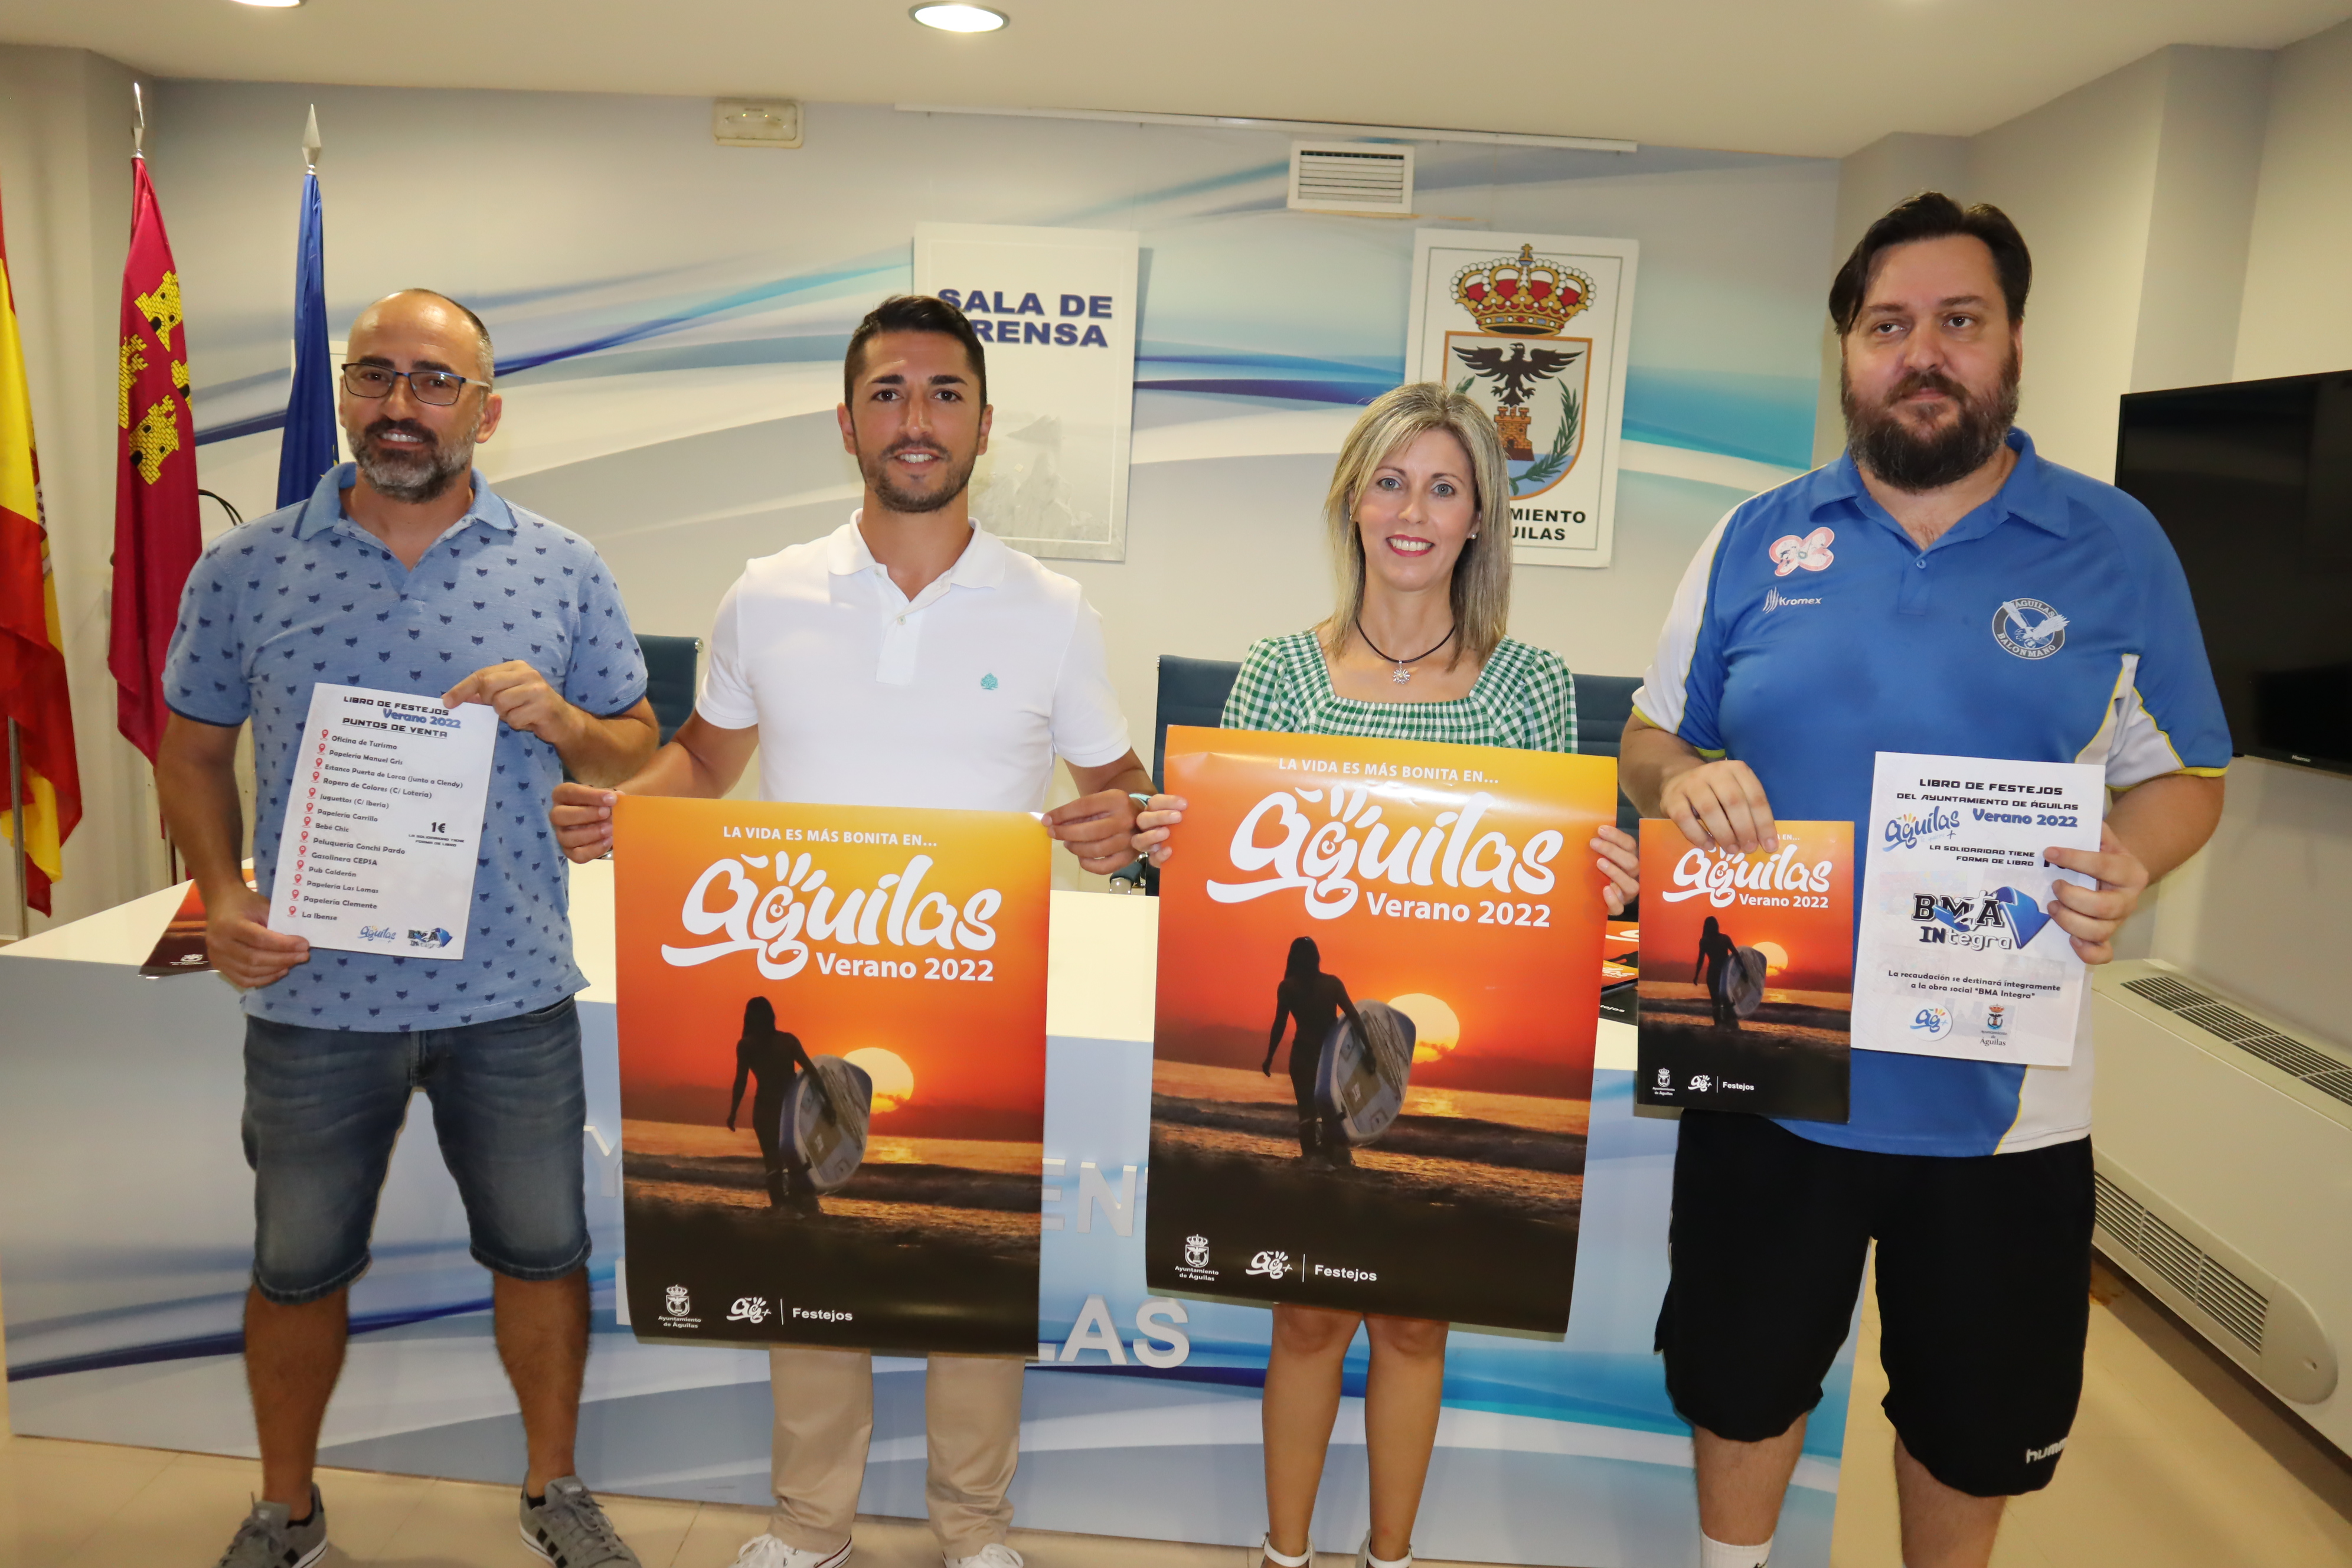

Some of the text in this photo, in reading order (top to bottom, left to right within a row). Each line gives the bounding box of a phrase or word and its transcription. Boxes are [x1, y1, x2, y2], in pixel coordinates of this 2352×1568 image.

[937, 288, 1113, 319] SALA DE
[969, 319, 1109, 348] RENSA
[1779, 596, 1822, 606] Kromex
[1997, 632, 2056, 657] BALONMANO
[344, 696, 374, 705] LIBRO
[394, 703, 449, 716] FESTEJOS
[383, 708, 461, 729] Verano 2022
[342, 717, 447, 737] PUNTOS DE VENTA
[332, 736, 357, 744] Oficina
[370, 740, 397, 750] Turismo
[329, 750, 361, 759] Papelería
[363, 754, 388, 763] Manuel
[325, 764, 349, 772] Estanco
[352, 767, 374, 776] Puerta
[437, 779, 463, 789] Clendy)
[1278, 758, 1499, 783] LA VIDA ES MÁS BONITA EN...
[323, 778, 348, 786] Ropero
[362, 783, 387, 792] Colores
[403, 789, 432, 799] Lotería)
[1920, 779, 2063, 795] LIBRO DE FESTEJOS
[320, 793, 352, 803] Juguettos
[366, 800, 390, 809] Iberia)
[1921, 795, 2008, 806] AYUNTAMIENTO
[2031, 801, 2079, 810] ÁGUILAS
[318, 809, 378, 822] Papelería Carrillo
[1972, 808, 2078, 828] Verano 2022
[432, 822, 446, 833] 1€
[313, 837, 354, 848] Peluquería
[356, 843, 380, 851] Conchi
[723, 826, 937, 847] LA VIDA ES MÁS BONITA EN...
[1943, 845, 2005, 855] SOLIDARIDAD
[312, 852, 378, 865] Gasolinera CEPSA
[325, 868, 357, 877] Calderón
[307, 880, 341, 889] Papelería
[303, 896, 377, 909] Papelería Clemente
[1739, 893, 1829, 908] Verano 2022
[1366, 891, 1551, 927] Verano 2022
[1912, 893, 2004, 927] BMA
[313, 913, 338, 921] Ibense
[1919, 926, 2011, 951] INtegra
[816, 952, 994, 982] Verano 2022
[1901, 972, 1949, 981] recaudación
[1962, 976, 2001, 986] destinará
[1980, 1037, 2006, 1046] Águilas
[1723, 1082, 1755, 1091] Festejos
[1175, 1266, 1219, 1275] Ayuntamiento
[1189, 1273, 1215, 1281] Águilas
[1314, 1265, 1377, 1281] Festejos
[792, 1308, 853, 1321] Festejos
[2026, 1436, 2068, 1464] humm
